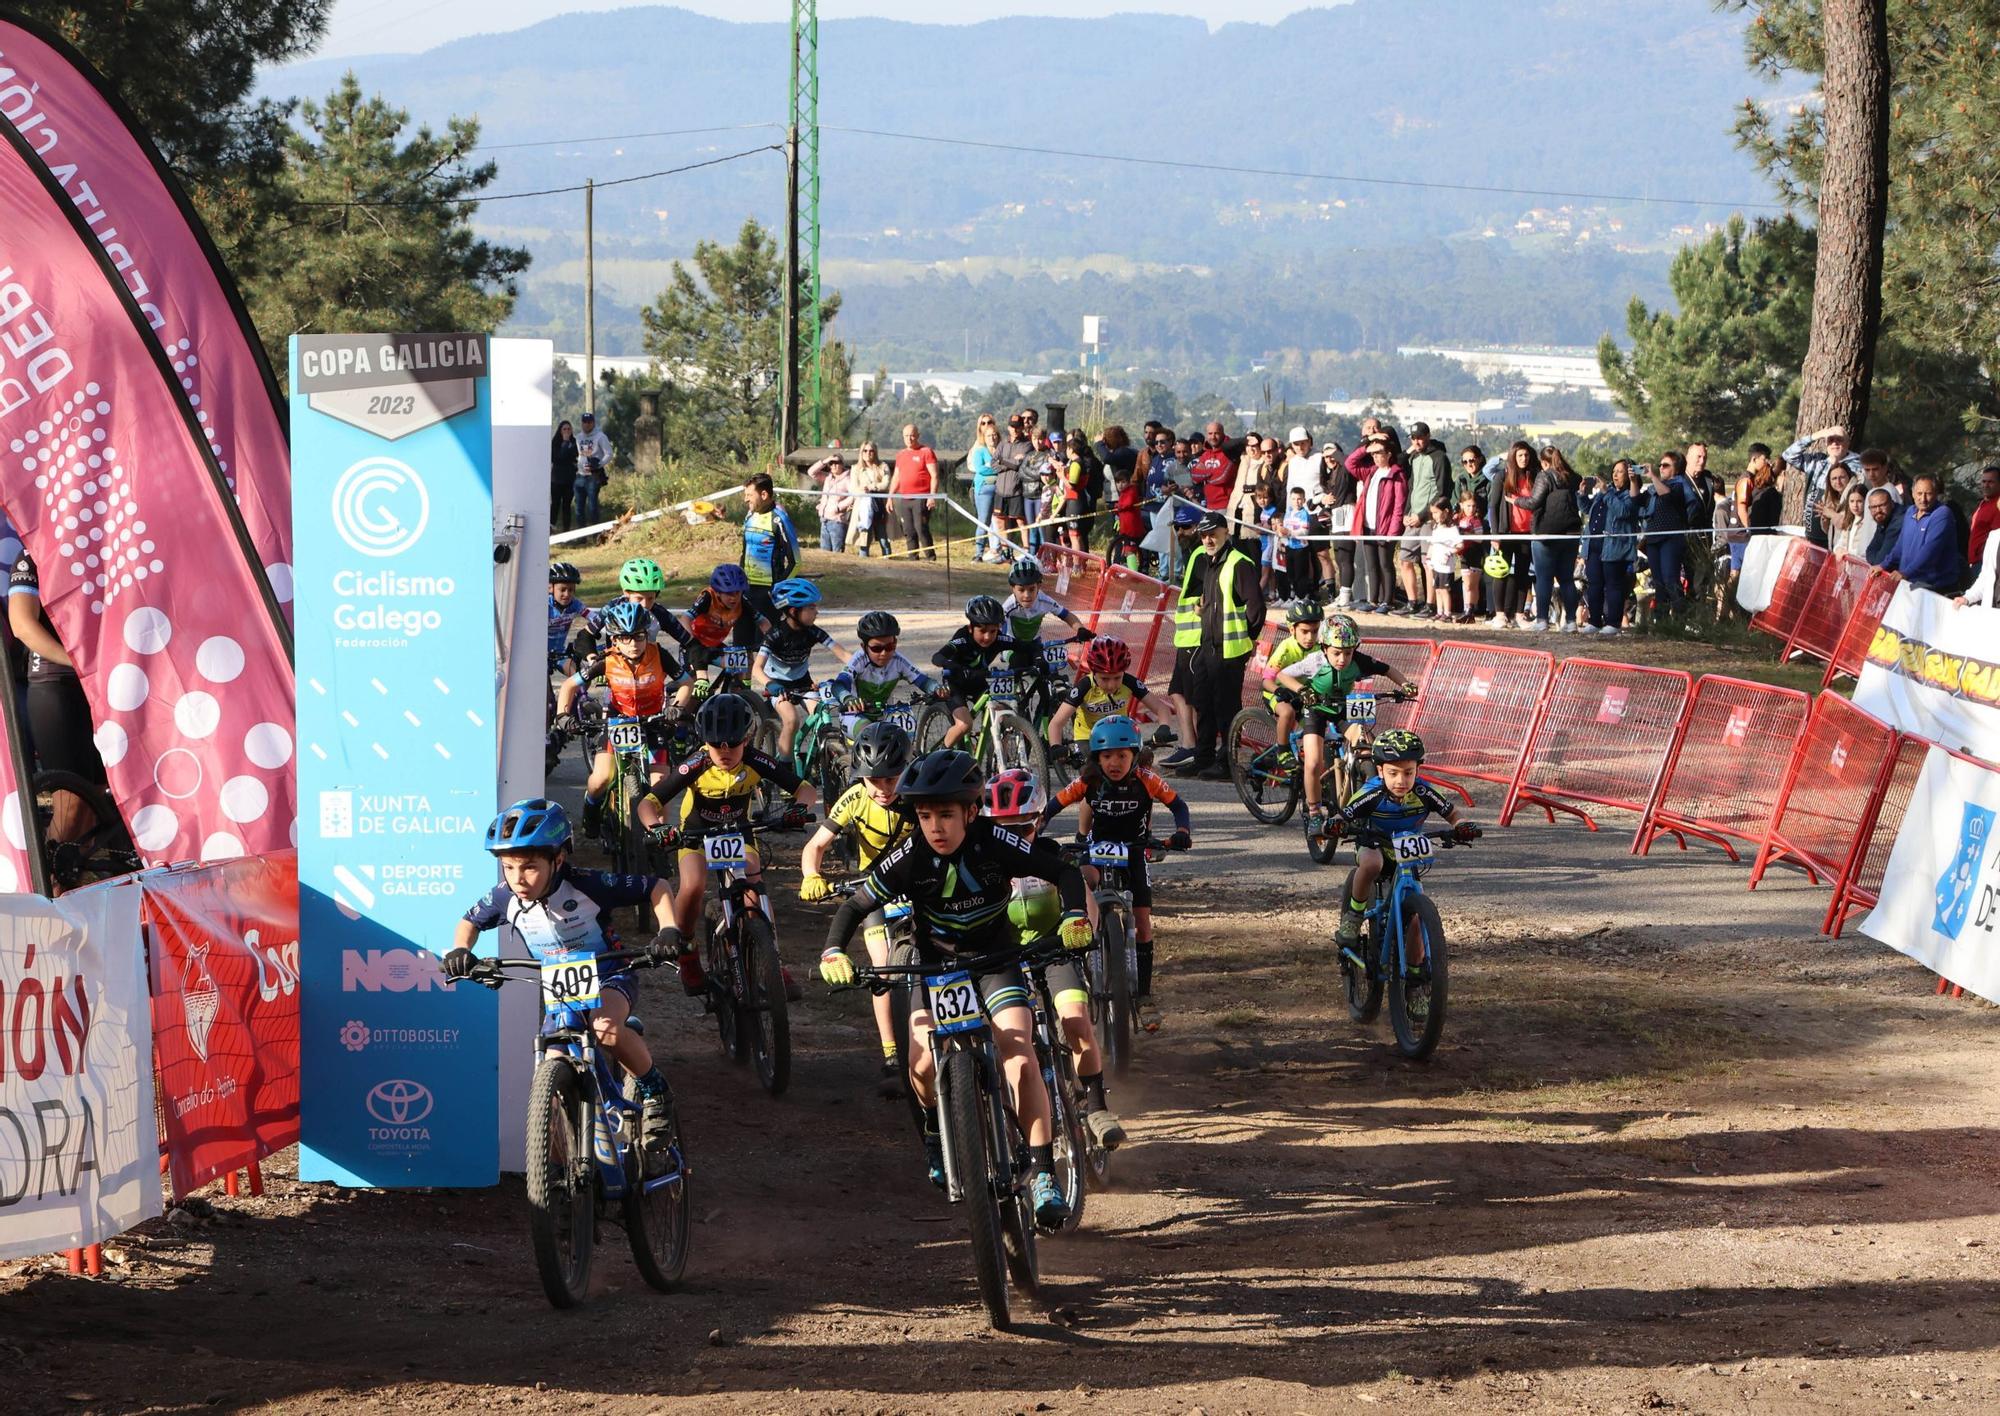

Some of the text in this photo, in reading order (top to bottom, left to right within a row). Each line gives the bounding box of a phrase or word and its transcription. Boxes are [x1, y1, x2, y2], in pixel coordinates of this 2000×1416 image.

[303, 338, 483, 377] COPA GALICIA
[367, 396, 415, 415] 2023
[333, 570, 455, 597] Ciclismo
[334, 604, 441, 636] Galego
[727, 652, 746, 667] 612
[993, 678, 1012, 693] 633
[1351, 701, 1373, 717] 617
[891, 714, 912, 731] 16
[613, 726, 639, 745] 613
[359, 795, 431, 812] XUNTA
[359, 816, 476, 834] DE GALICIA
[711, 838, 743, 859] 602
[1400, 836, 1429, 859] 630
[382, 864, 463, 879] DEPORTE
[382, 881, 455, 896] GALEGO
[552, 964, 593, 999] 609
[936, 985, 975, 1021] 632
[373, 1029, 460, 1042] OTTOBOSLEY
[201, 1081, 214, 1105] do
[368, 1128, 431, 1140] TOYOTA
